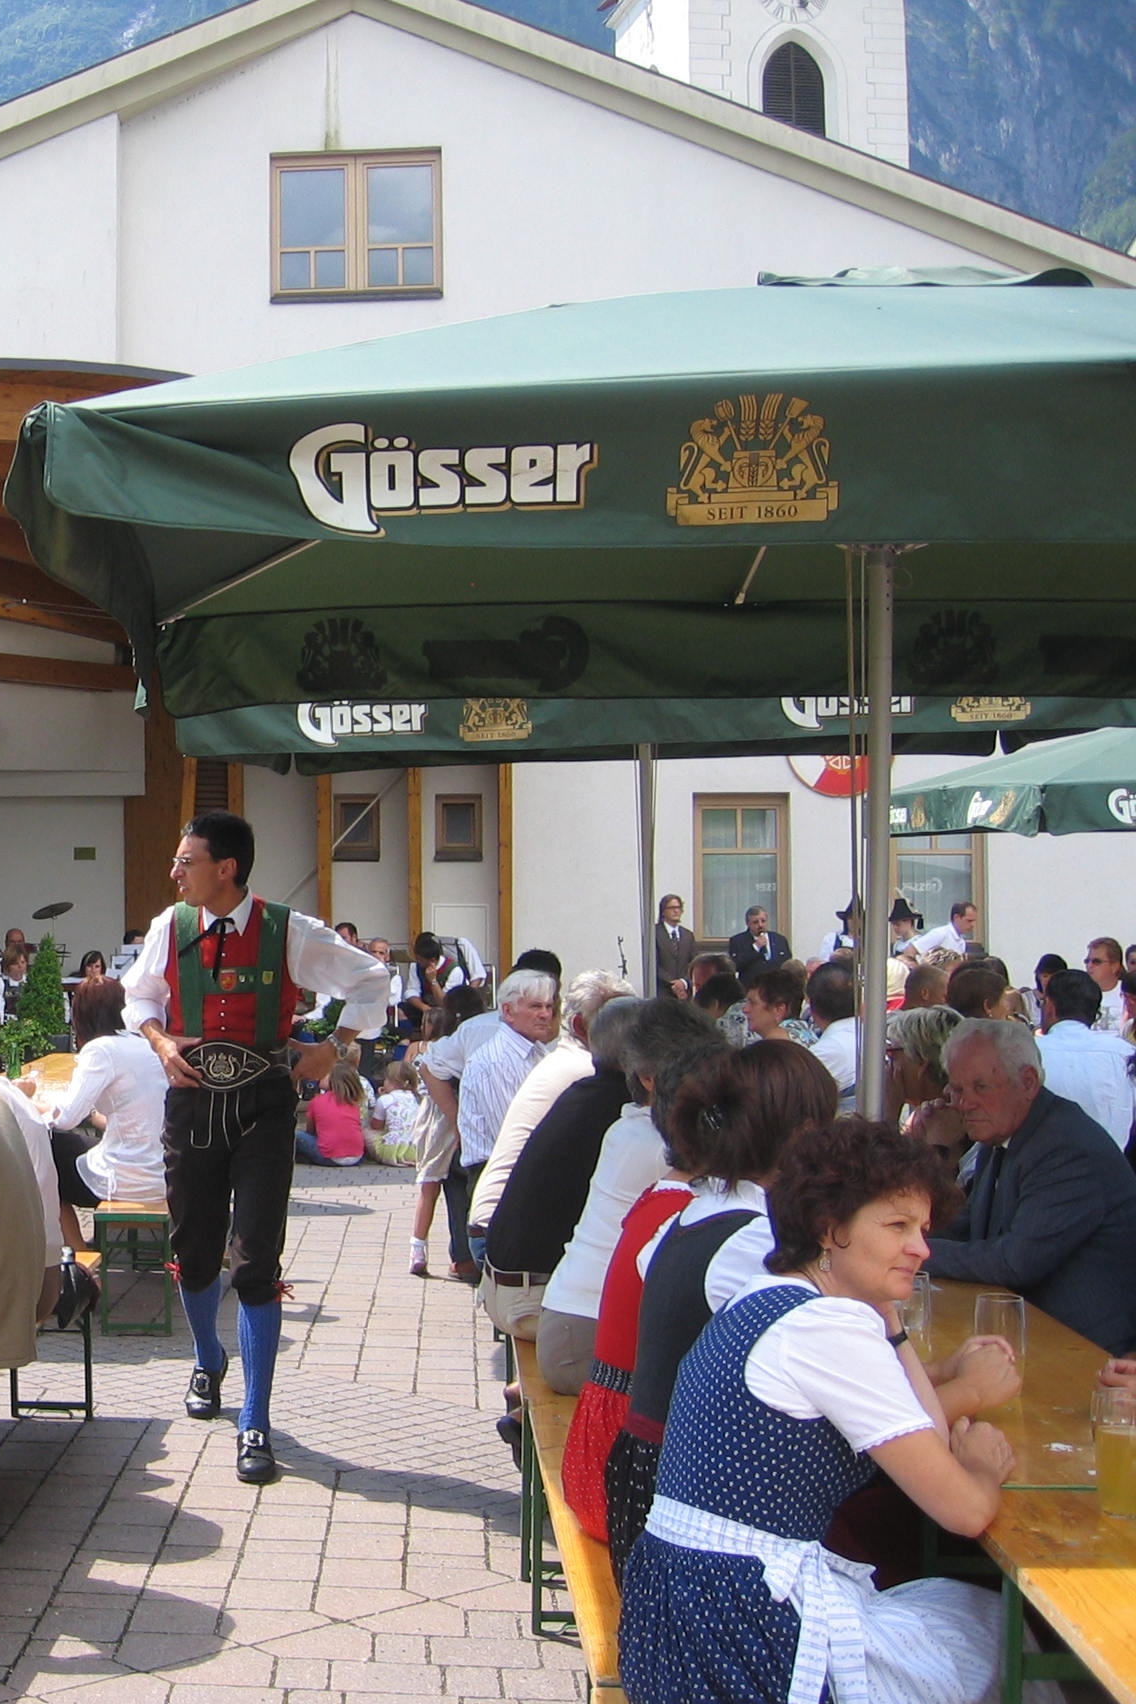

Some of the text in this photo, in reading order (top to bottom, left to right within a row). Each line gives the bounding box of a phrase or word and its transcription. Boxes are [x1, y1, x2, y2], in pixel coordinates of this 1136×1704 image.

[288, 421, 595, 535] Gösser
[707, 504, 799, 520] SEIT 1860
[297, 700, 425, 746] Gösser
